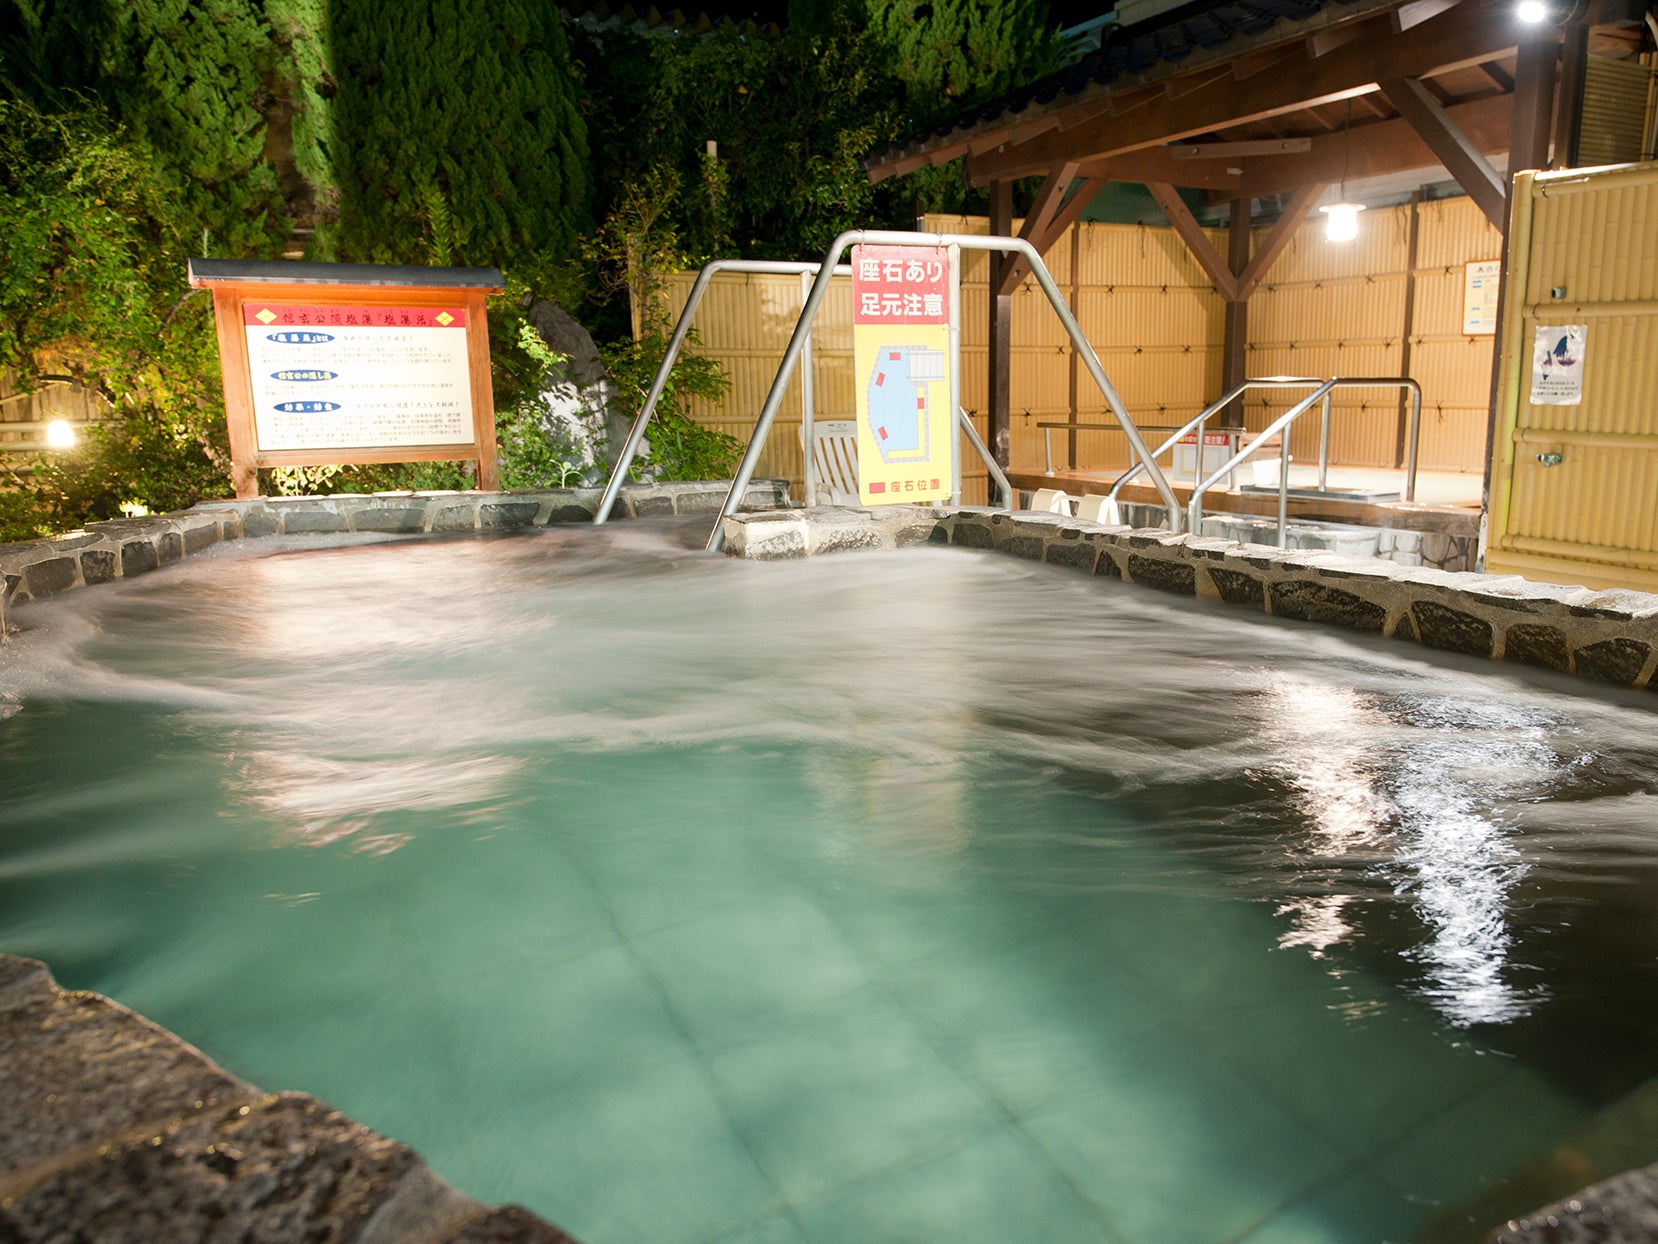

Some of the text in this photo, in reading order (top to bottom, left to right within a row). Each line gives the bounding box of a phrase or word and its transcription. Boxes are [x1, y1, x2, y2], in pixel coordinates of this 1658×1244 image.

[858, 258, 943, 283] 座石あり
[860, 292, 943, 317] 足元注意
[890, 478, 940, 493] 座石位置
